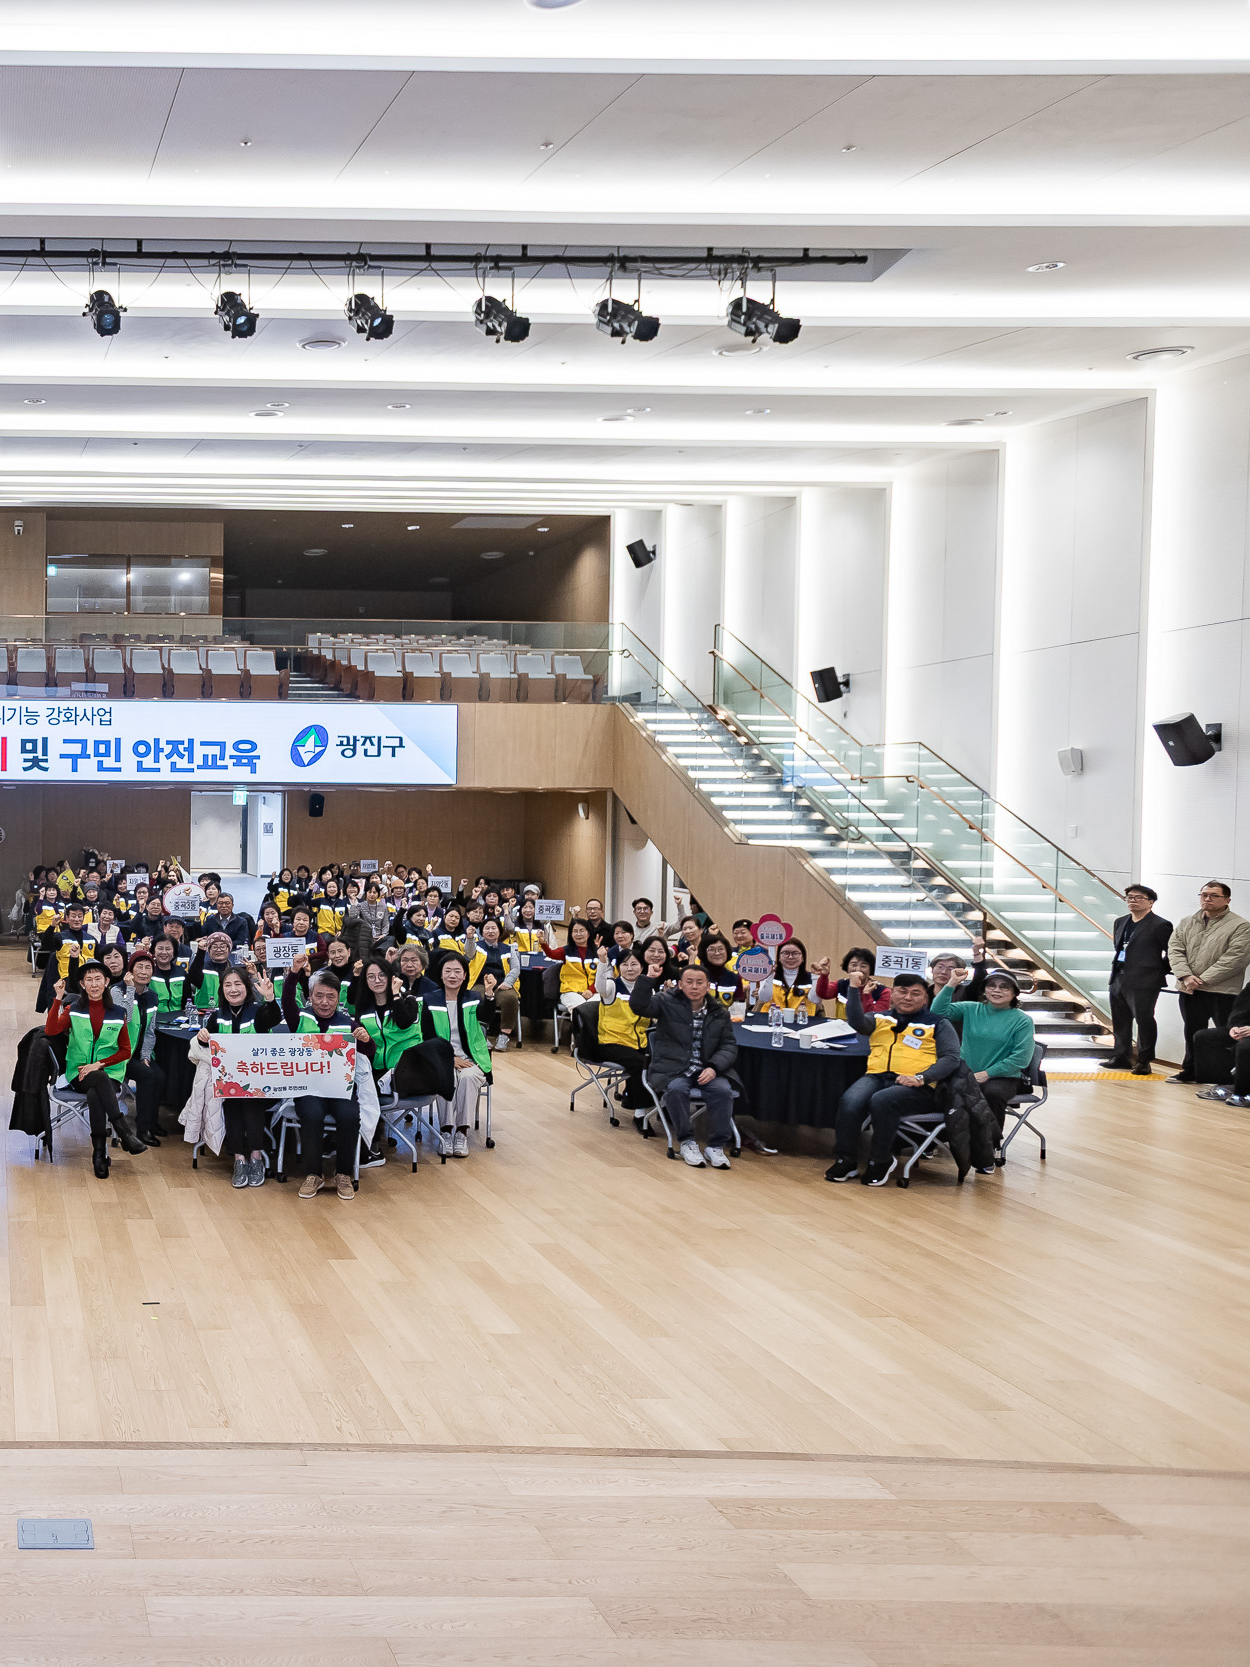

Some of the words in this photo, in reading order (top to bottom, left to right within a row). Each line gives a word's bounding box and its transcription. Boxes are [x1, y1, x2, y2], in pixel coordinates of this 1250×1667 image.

[45, 706, 113, 726] 강화사업
[335, 735, 406, 759] 광진구
[20, 736, 50, 772] 및
[59, 737, 122, 773] 구민
[132, 737, 261, 774] 안전교육
[174, 901, 196, 911] 중곡3동
[538, 905, 561, 914] 중곡2동
[273, 946, 299, 958] 광장동
[881, 955, 922, 970] 중곡1동
[251, 1047, 268, 1057] 살기
[270, 1047, 286, 1057] 좋은
[288, 1047, 314, 1057] 광장동
[236, 1060, 332, 1077] 축하드립니다!
